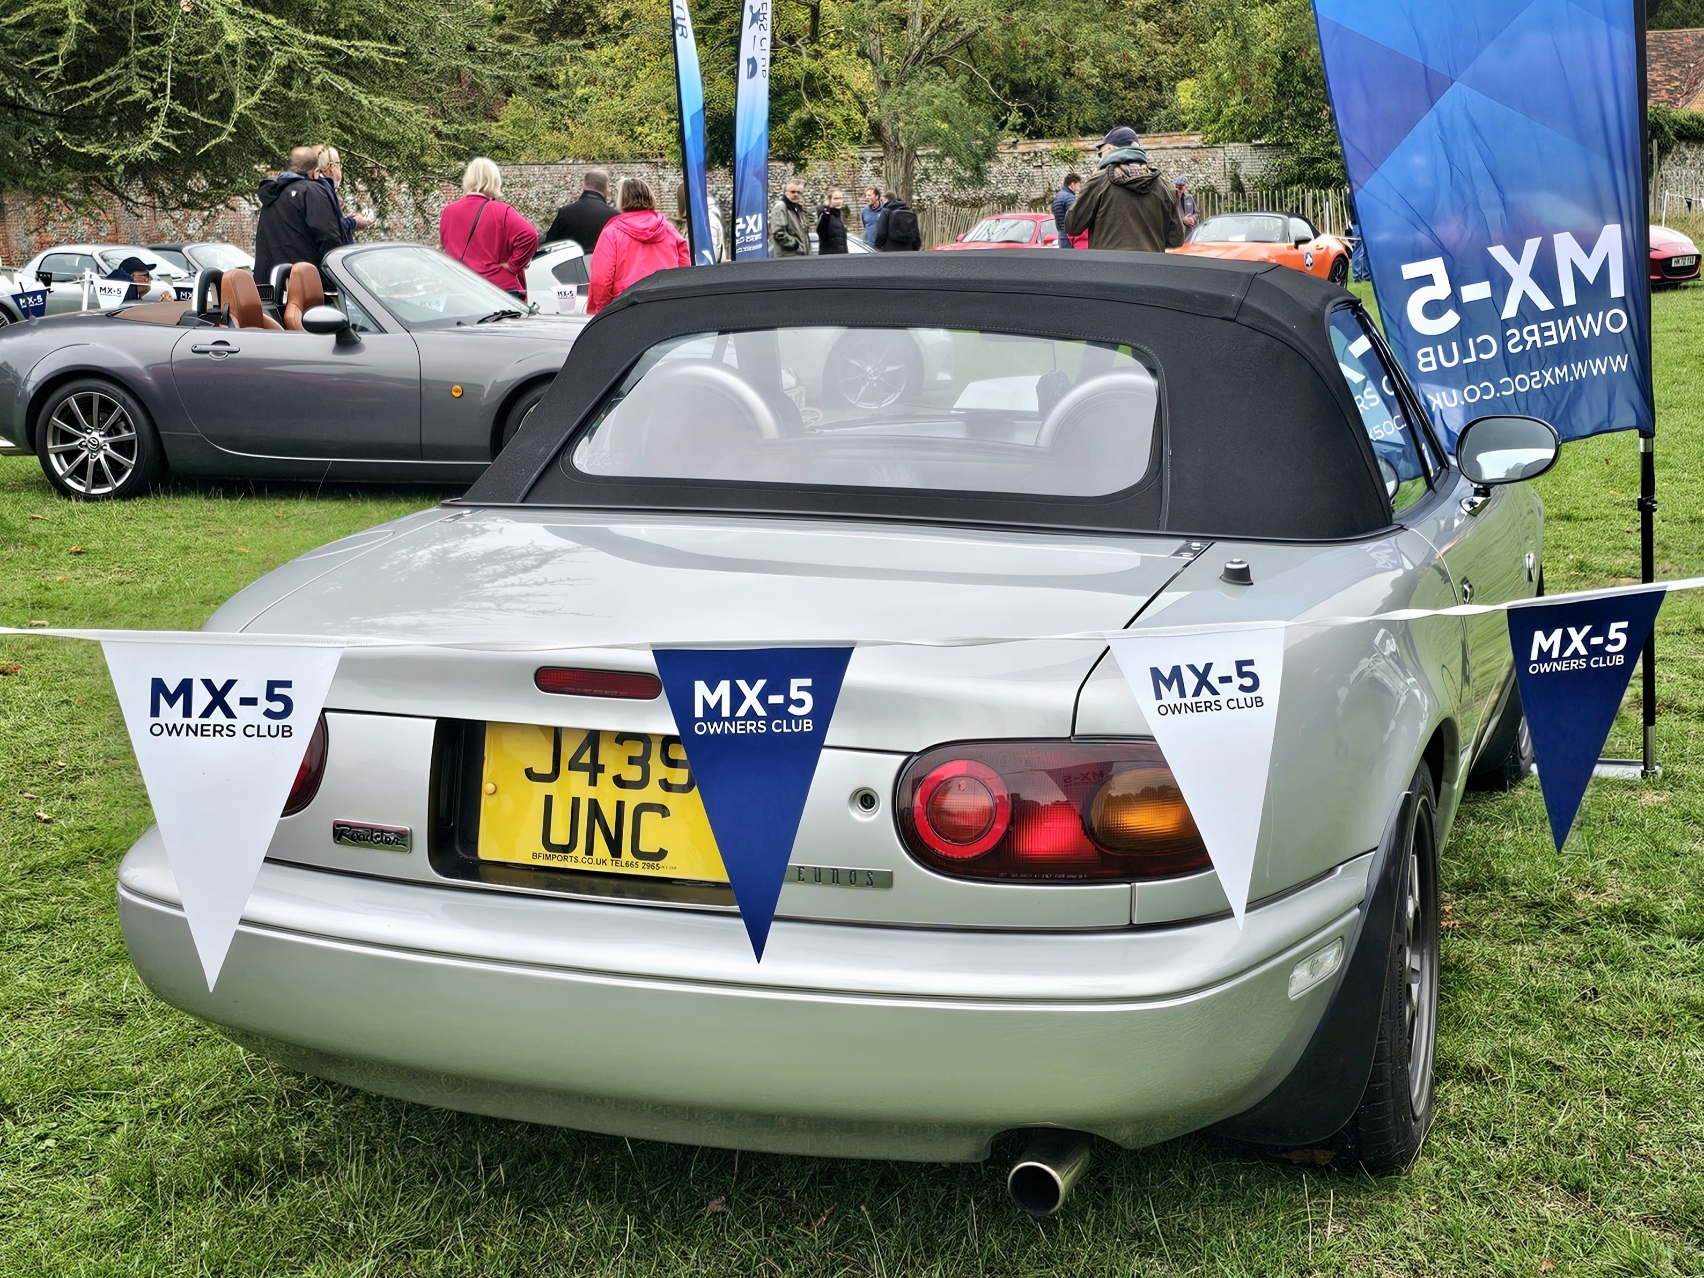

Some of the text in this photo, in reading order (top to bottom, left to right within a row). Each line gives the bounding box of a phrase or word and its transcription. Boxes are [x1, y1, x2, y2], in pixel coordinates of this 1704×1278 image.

[19, 294, 43, 306] MX-5
[99, 287, 122, 295] MX-5
[1530, 621, 1629, 660] MX-5
[1528, 655, 1624, 674] OWNERS CLUB
[1150, 659, 1260, 700] MX-5
[150, 678, 294, 720] MX-5
[694, 678, 814, 718] MX-5
[1157, 696, 1264, 716] OWNERS CLUB
[150, 723, 293, 738] OWNERS CLUB
[694, 719, 814, 735] OWNERS CLUB
[524, 727, 697, 793] J439
[541, 795, 671, 861] UNC
[531, 852, 608, 867] BFIMPORTS.CO.UK
[641, 861, 661, 871] 2965
